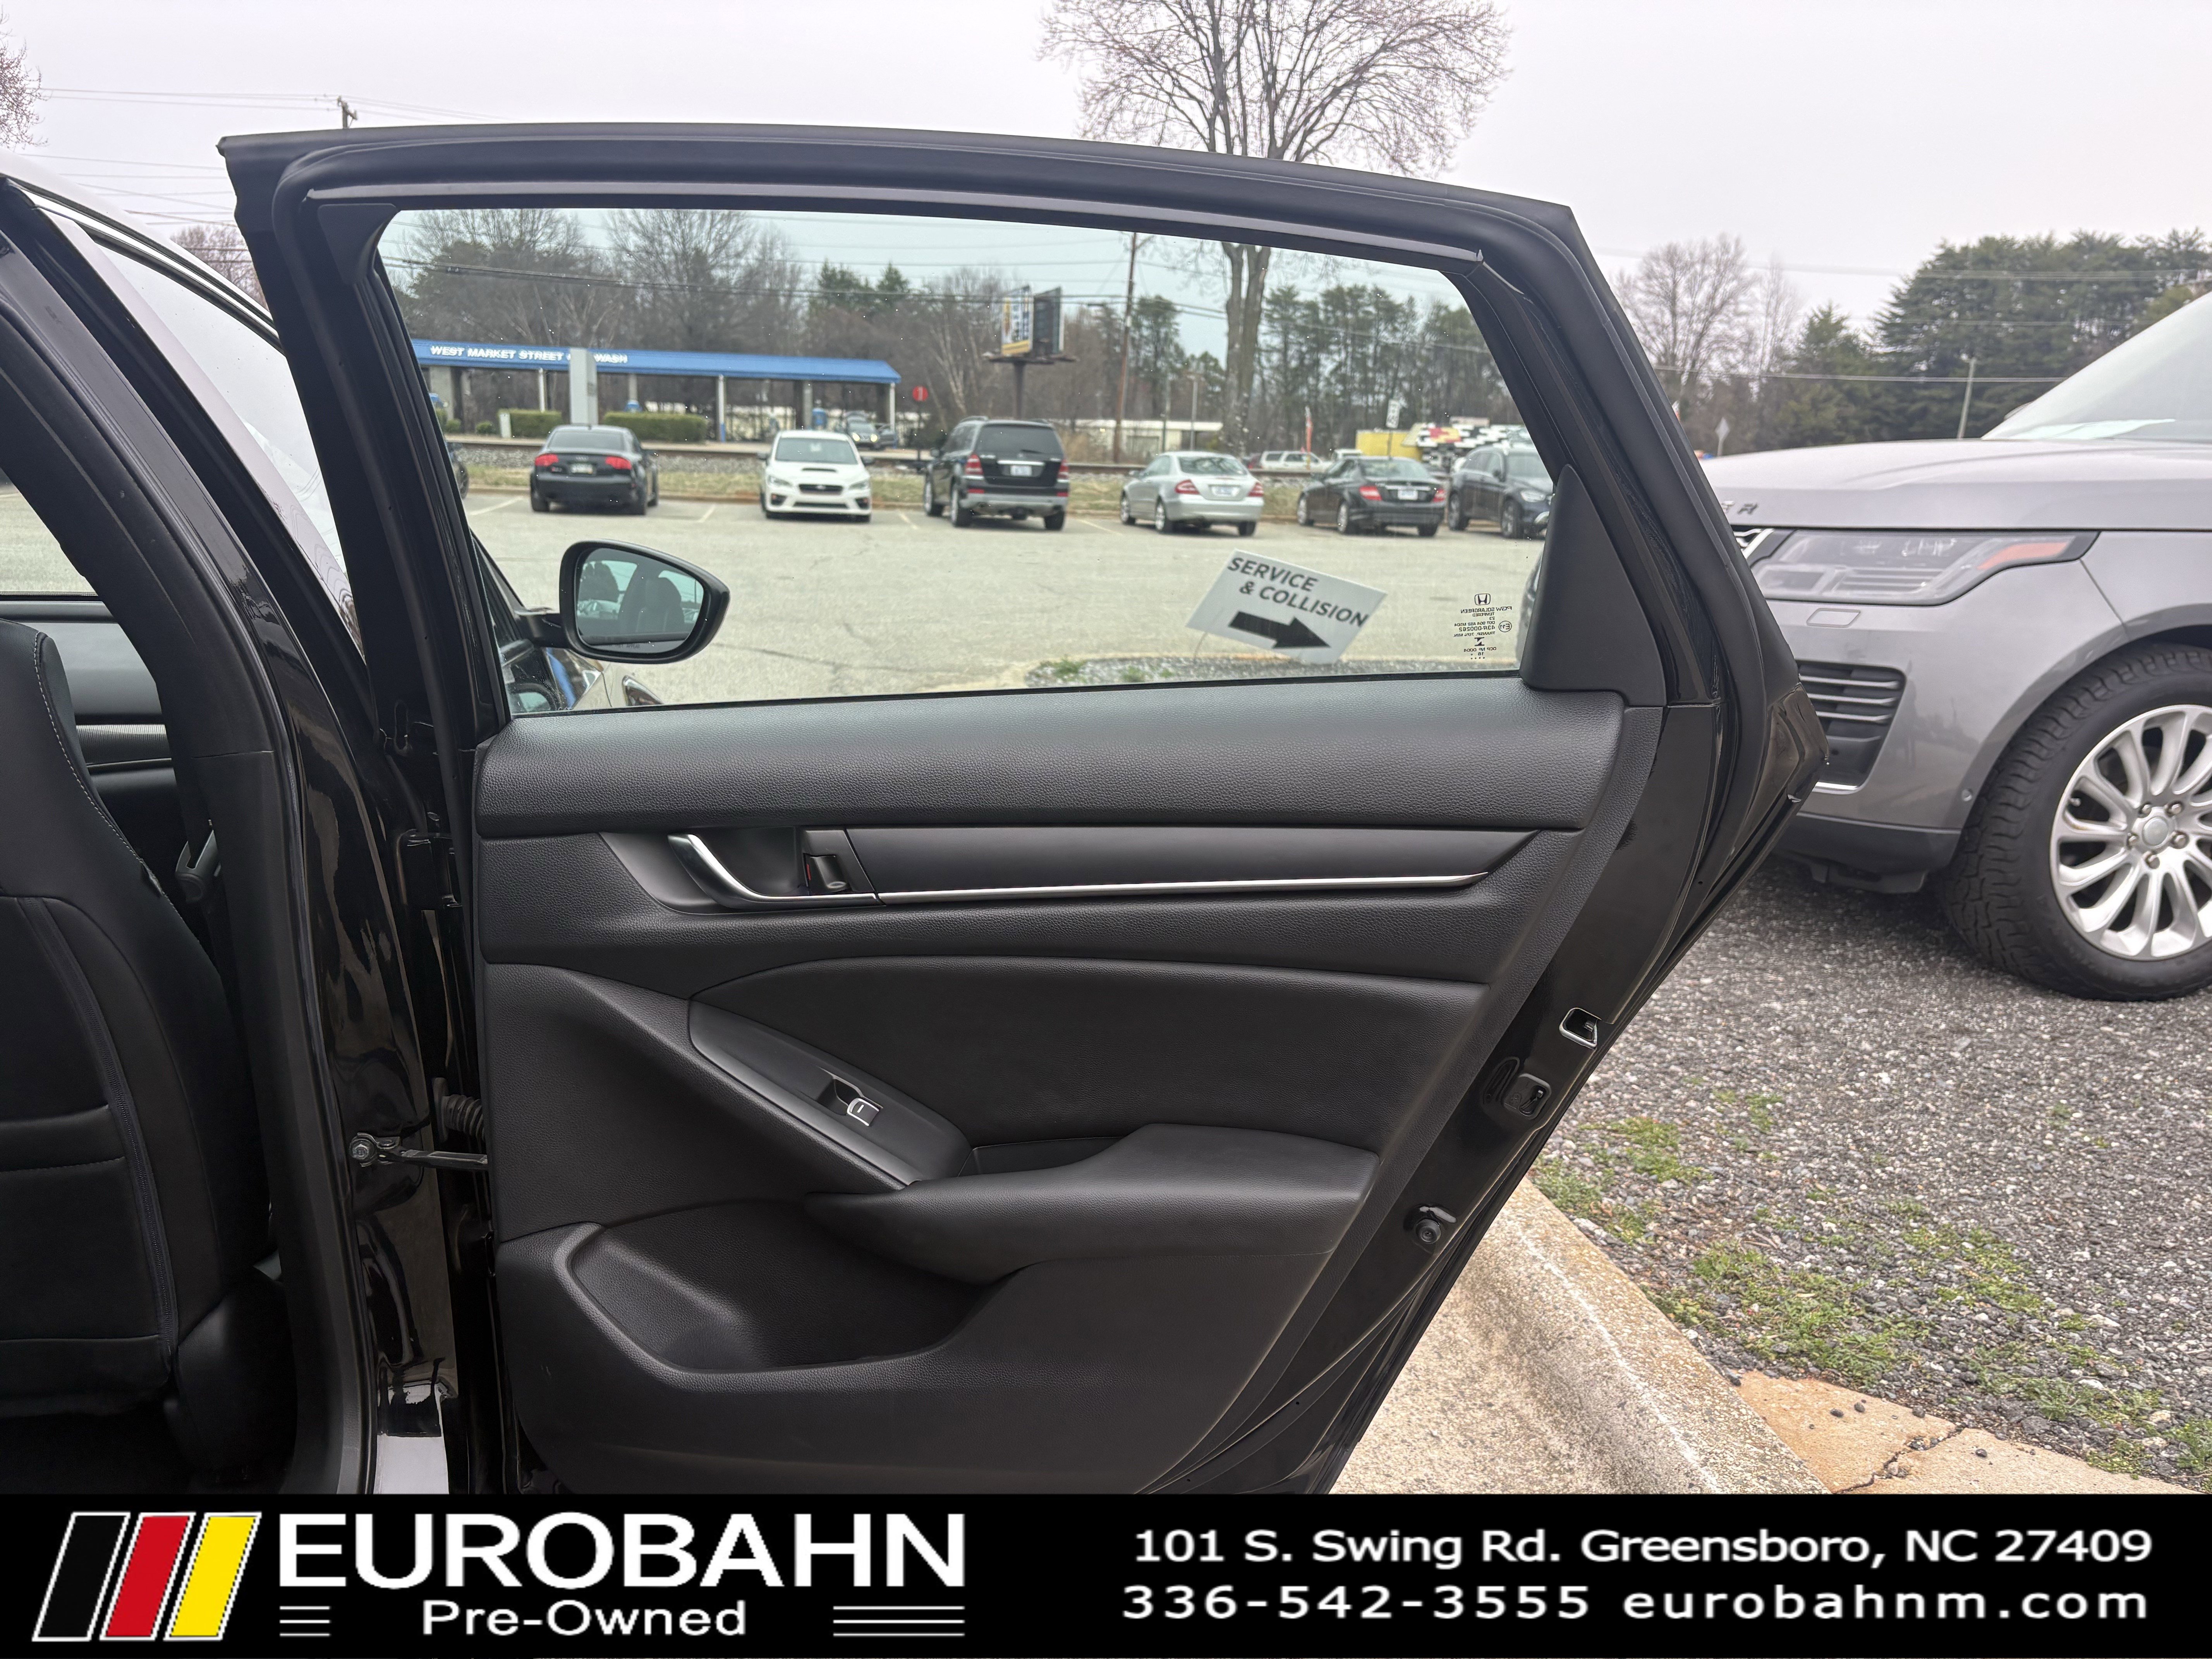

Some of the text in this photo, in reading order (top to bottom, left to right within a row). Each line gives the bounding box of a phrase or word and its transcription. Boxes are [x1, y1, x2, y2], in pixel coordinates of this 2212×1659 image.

[430, 346, 465, 356] WEST
[467, 348, 517, 359] MARKET
[519, 350, 564, 361] STREET
[593, 354, 628, 364] WASH
[1227, 557, 1319, 592] SERVICE
[1239, 581, 1369, 627] & COLLISION
